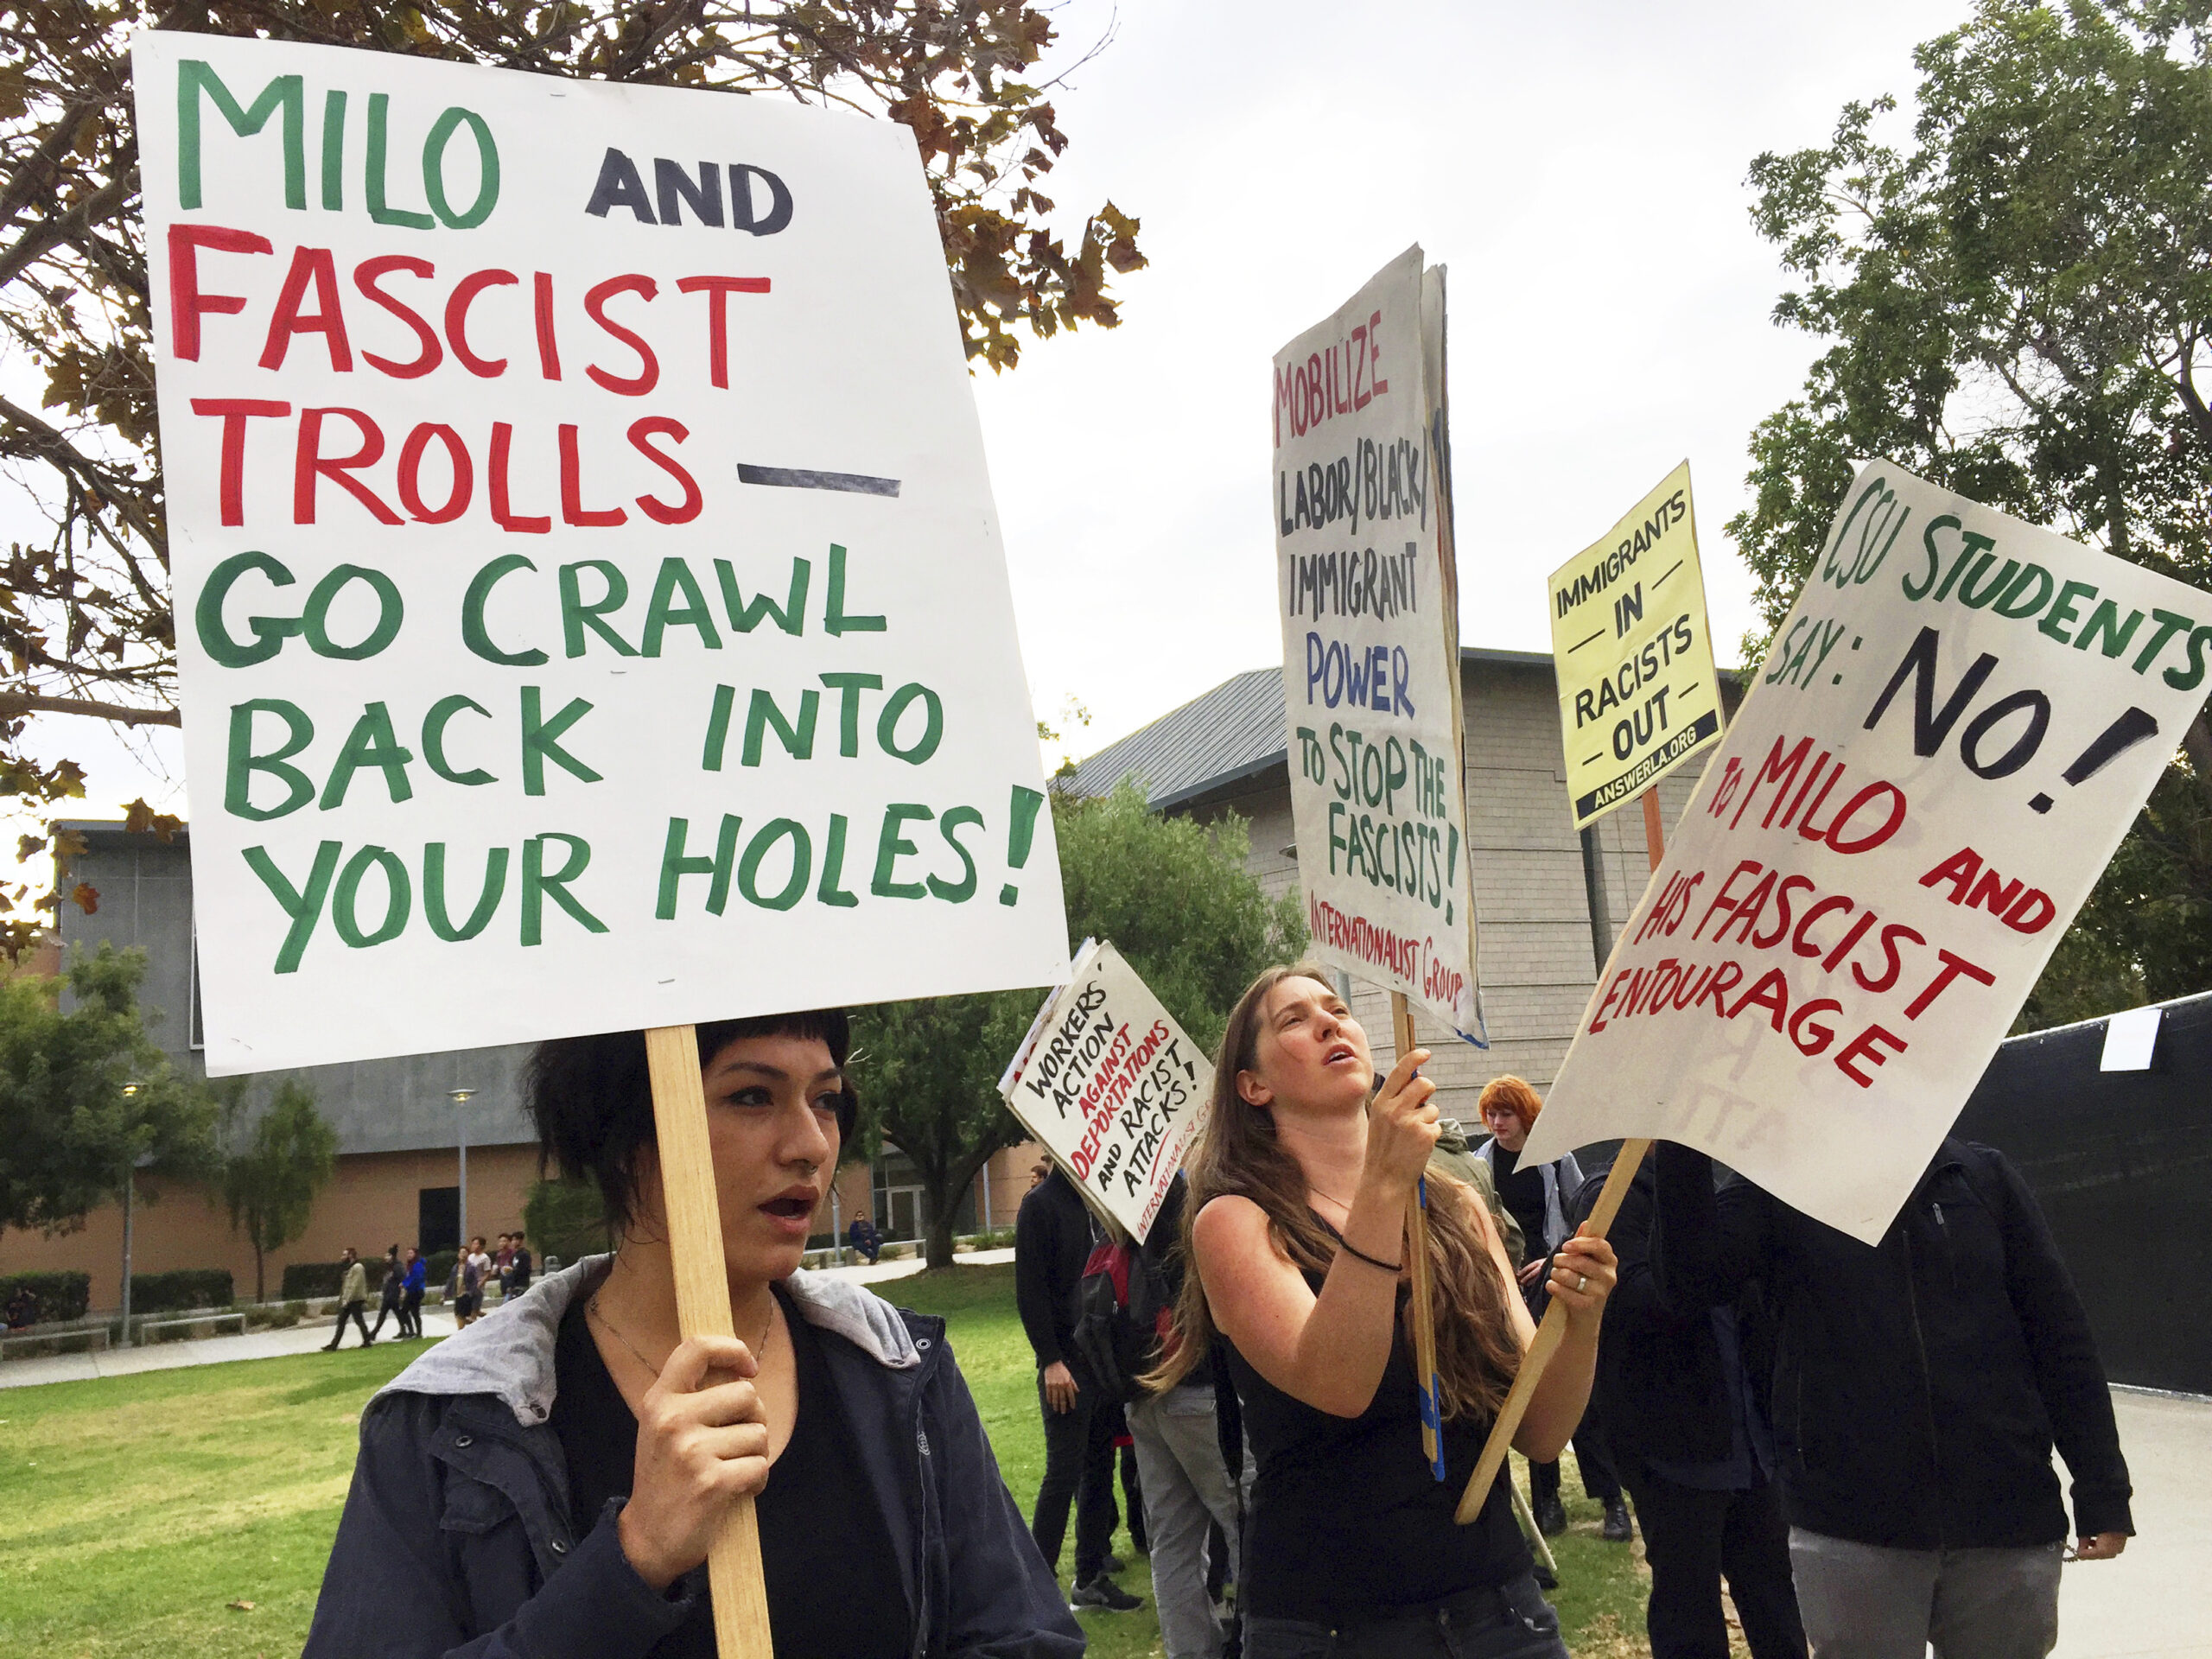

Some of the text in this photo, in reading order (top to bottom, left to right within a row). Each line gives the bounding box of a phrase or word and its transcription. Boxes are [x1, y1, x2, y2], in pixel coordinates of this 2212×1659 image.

[178, 59, 793, 236] MILO AND
[168, 224, 771, 395] FASCIST
[1276, 310, 1388, 448] MOBILIZE
[190, 398, 702, 533] TROLLS
[195, 543, 887, 668] GO CRAWL
[1290, 542, 1416, 622] IMMIGRANT
[1555, 489, 1686, 620] IMMIGRANTS
[1614, 581, 1643, 639] IN
[1823, 477, 2212, 691] CSU STUDENTS
[1306, 632, 1414, 720] POWER
[1575, 613, 1694, 728] RACISTS
[1612, 684, 1669, 761] OUT
[1766, 616, 2160, 815] SAY: NO!
[225, 673, 943, 822] BACK INTO
[1329, 722, 1407, 817] STOP
[1410, 738, 1446, 819] THE
[1594, 725, 1698, 809] ANSWERLA.ORG
[241, 785, 1044, 974] YOUR HOLES!
[1329, 802, 1459, 925] FASCISTS!
[1729, 735, 1906, 854] MILO
[1918, 847, 2056, 934] AND
[1309, 890, 1463, 1012] INTERNATIONALIST GROUP
[1634, 861, 1996, 1020] HIS FASCIST
[1052, 1013, 1116, 1119] ACTION
[1079, 1022, 1130, 1120] AGAINST
[1588, 958, 1908, 1088] ENTOURAGE
[1070, 1020, 1169, 1181] DEPORTATIONS
[1096, 1039, 1179, 1192] AND RACIST
[1122, 1060, 1198, 1198] ATTACKS!
